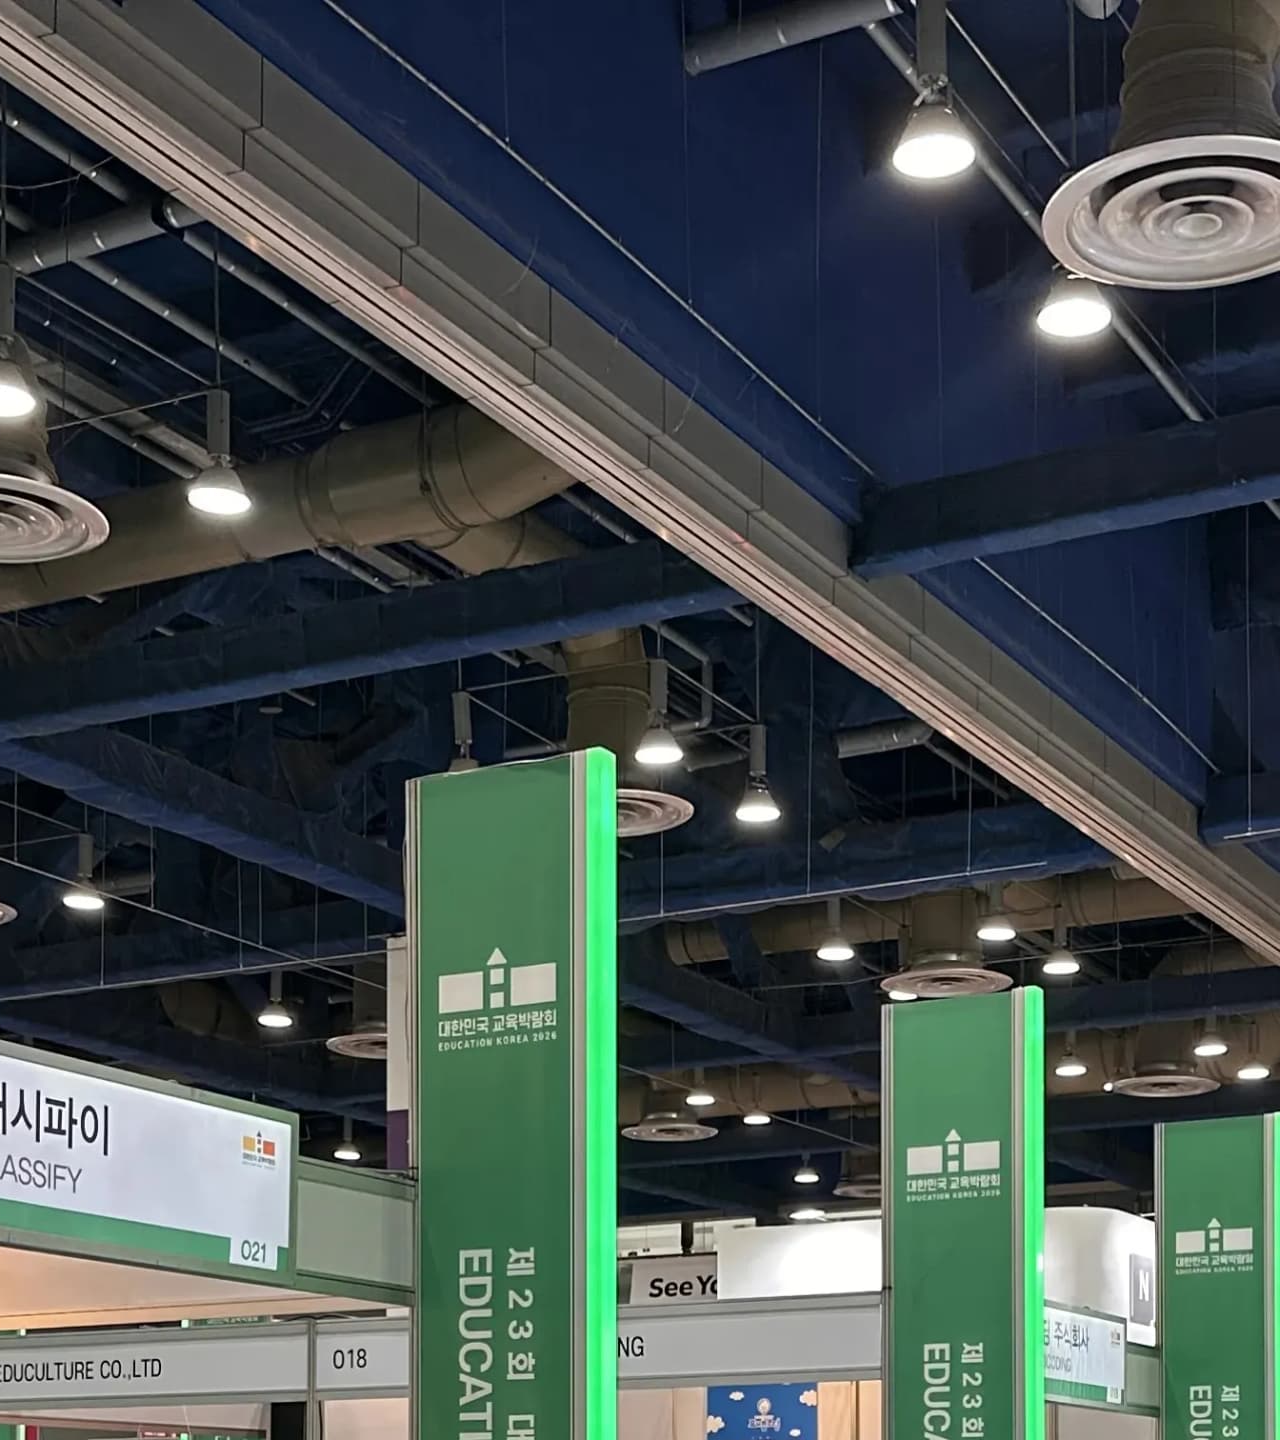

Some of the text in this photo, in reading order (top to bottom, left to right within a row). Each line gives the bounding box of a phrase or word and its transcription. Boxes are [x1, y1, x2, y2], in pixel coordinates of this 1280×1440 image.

[438, 1009, 557, 1037] 대한민국 교육박람회
[438, 1031, 557, 1051] EDUCATION KOREA 2026
[907, 1179, 947, 1192] 대한민국
[241, 1240, 266, 1263] 021
[649, 1278, 693, 1298] See
[1054, 1322, 1089, 1350] 주식회사
[99, 1359, 162, 1380] CO.,LTD
[332, 1348, 368, 1370] 018
